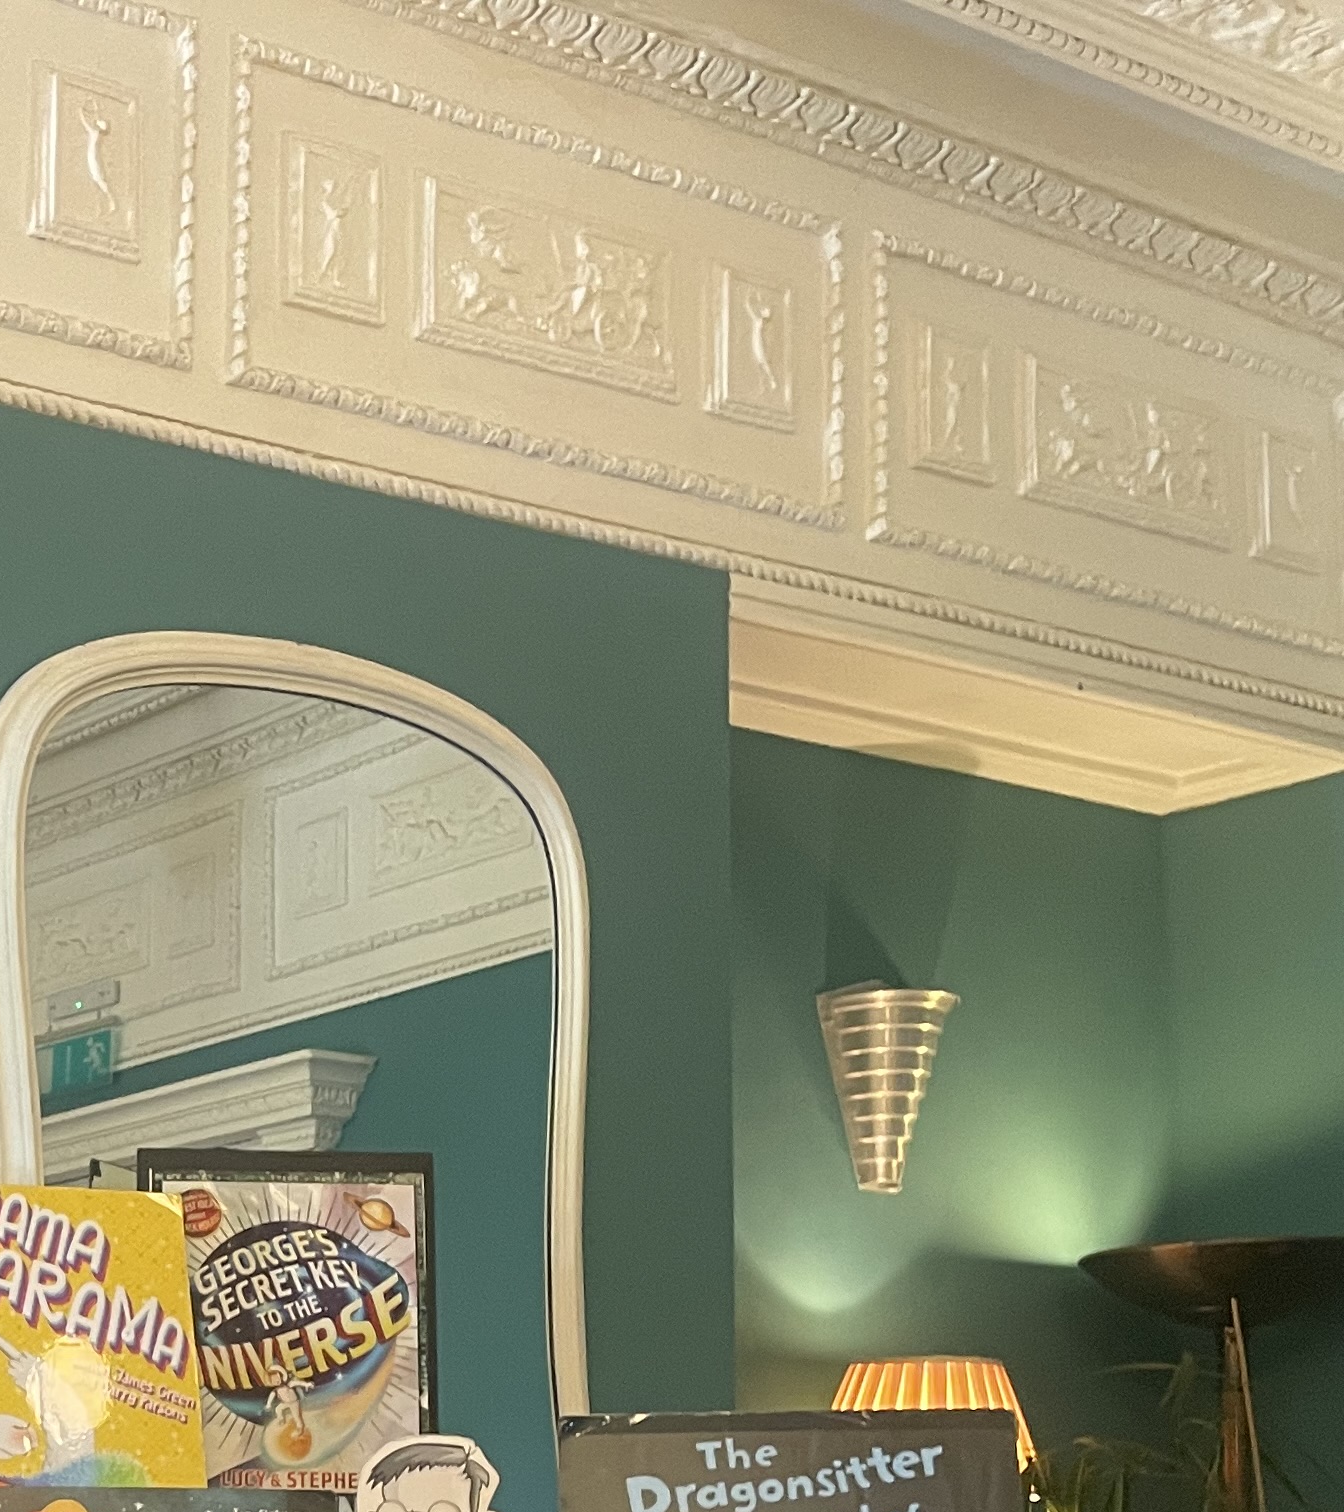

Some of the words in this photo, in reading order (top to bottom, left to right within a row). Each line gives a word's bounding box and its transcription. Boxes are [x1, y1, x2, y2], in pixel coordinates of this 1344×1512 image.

[194, 1228, 339, 1296] GEORGE'S
[200, 1263, 304, 1333] SECRET
[311, 1258, 362, 1291] KEY
[256, 1309, 282, 1331] TO
[284, 1294, 322, 1322] THE
[199, 1272, 412, 1392] NIVERSE
[113, 1367, 155, 1394] James
[158, 1384, 197, 1411] Green
[140, 1392, 189, 1424] Parsons
[695, 1437, 779, 1471] The
[220, 1471, 265, 1489] LUCY
[270, 1474, 281, 1488] &
[286, 1470, 359, 1490] STEPHE
